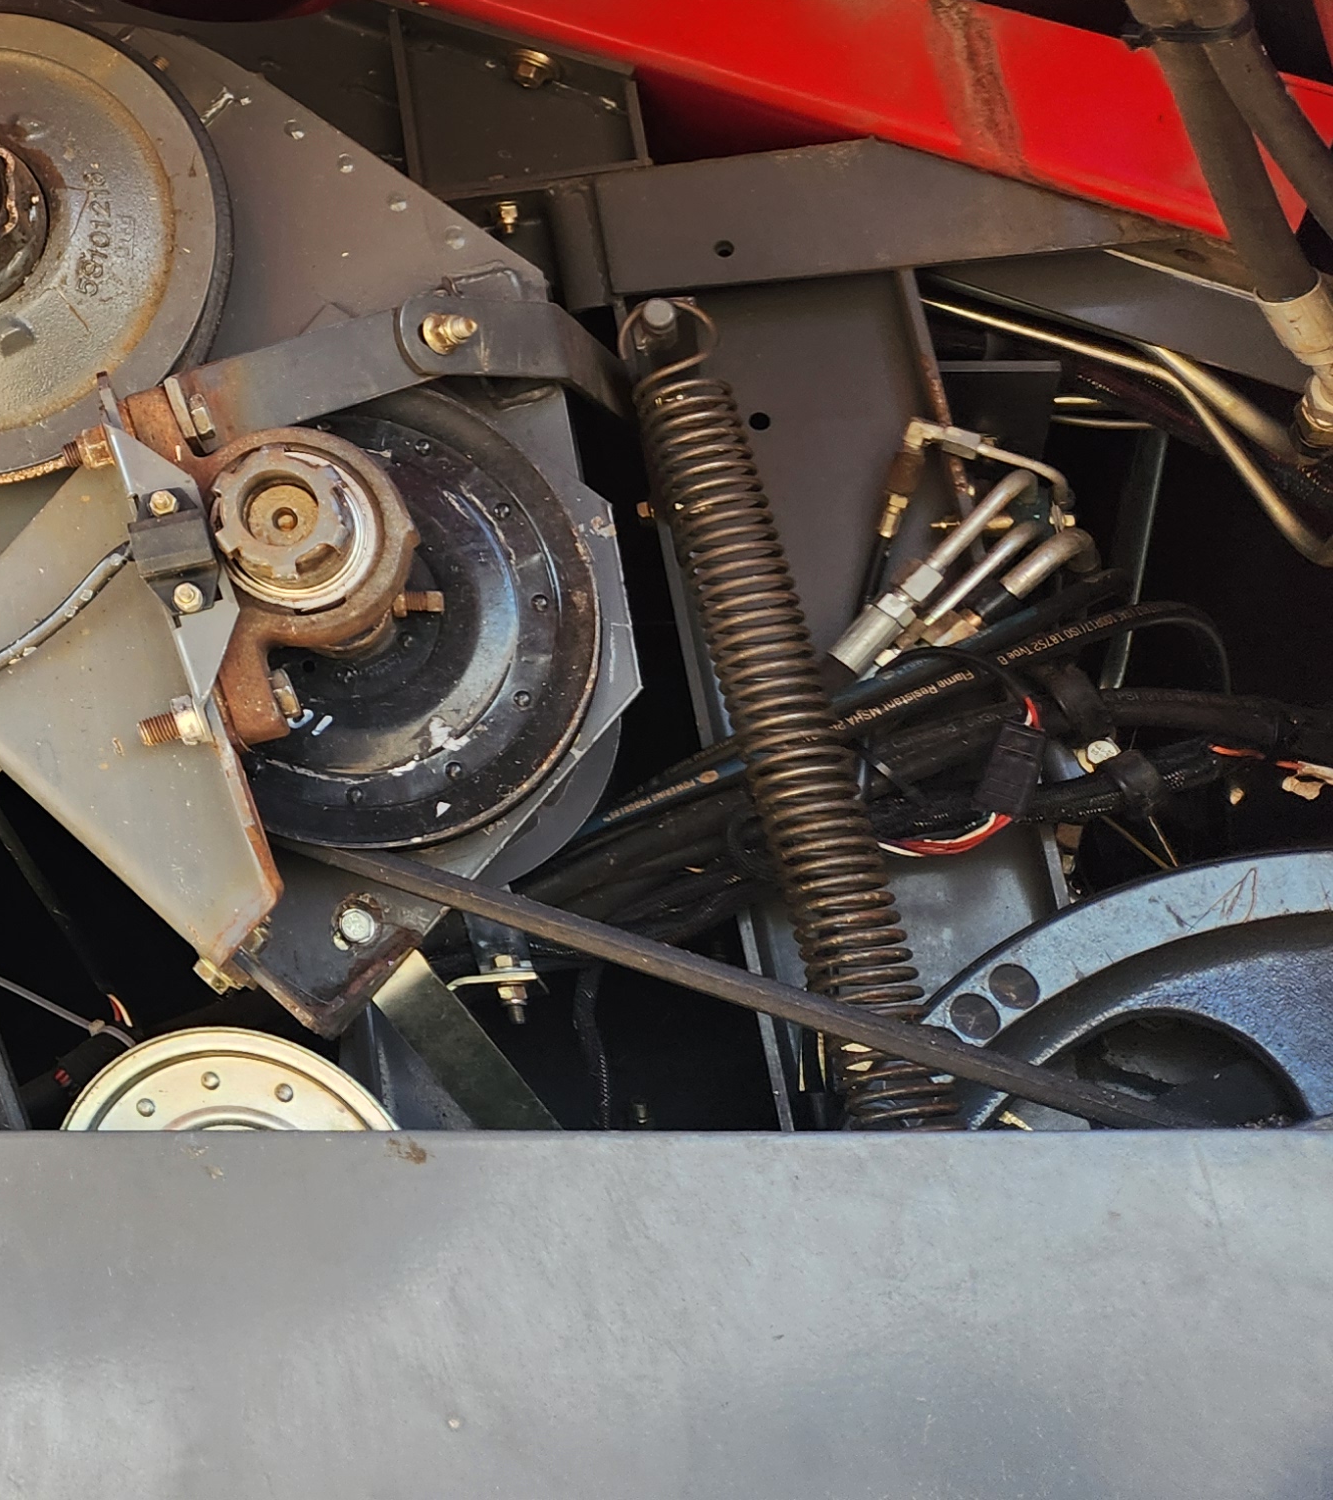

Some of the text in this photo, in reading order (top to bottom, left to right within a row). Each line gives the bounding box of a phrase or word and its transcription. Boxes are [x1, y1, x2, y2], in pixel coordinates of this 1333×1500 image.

[1032, 632, 1066, 652] 18752
[940, 669, 975, 689] Flame
[883, 682, 939, 710] Resistant
[846, 706, 883, 726] MSHA
